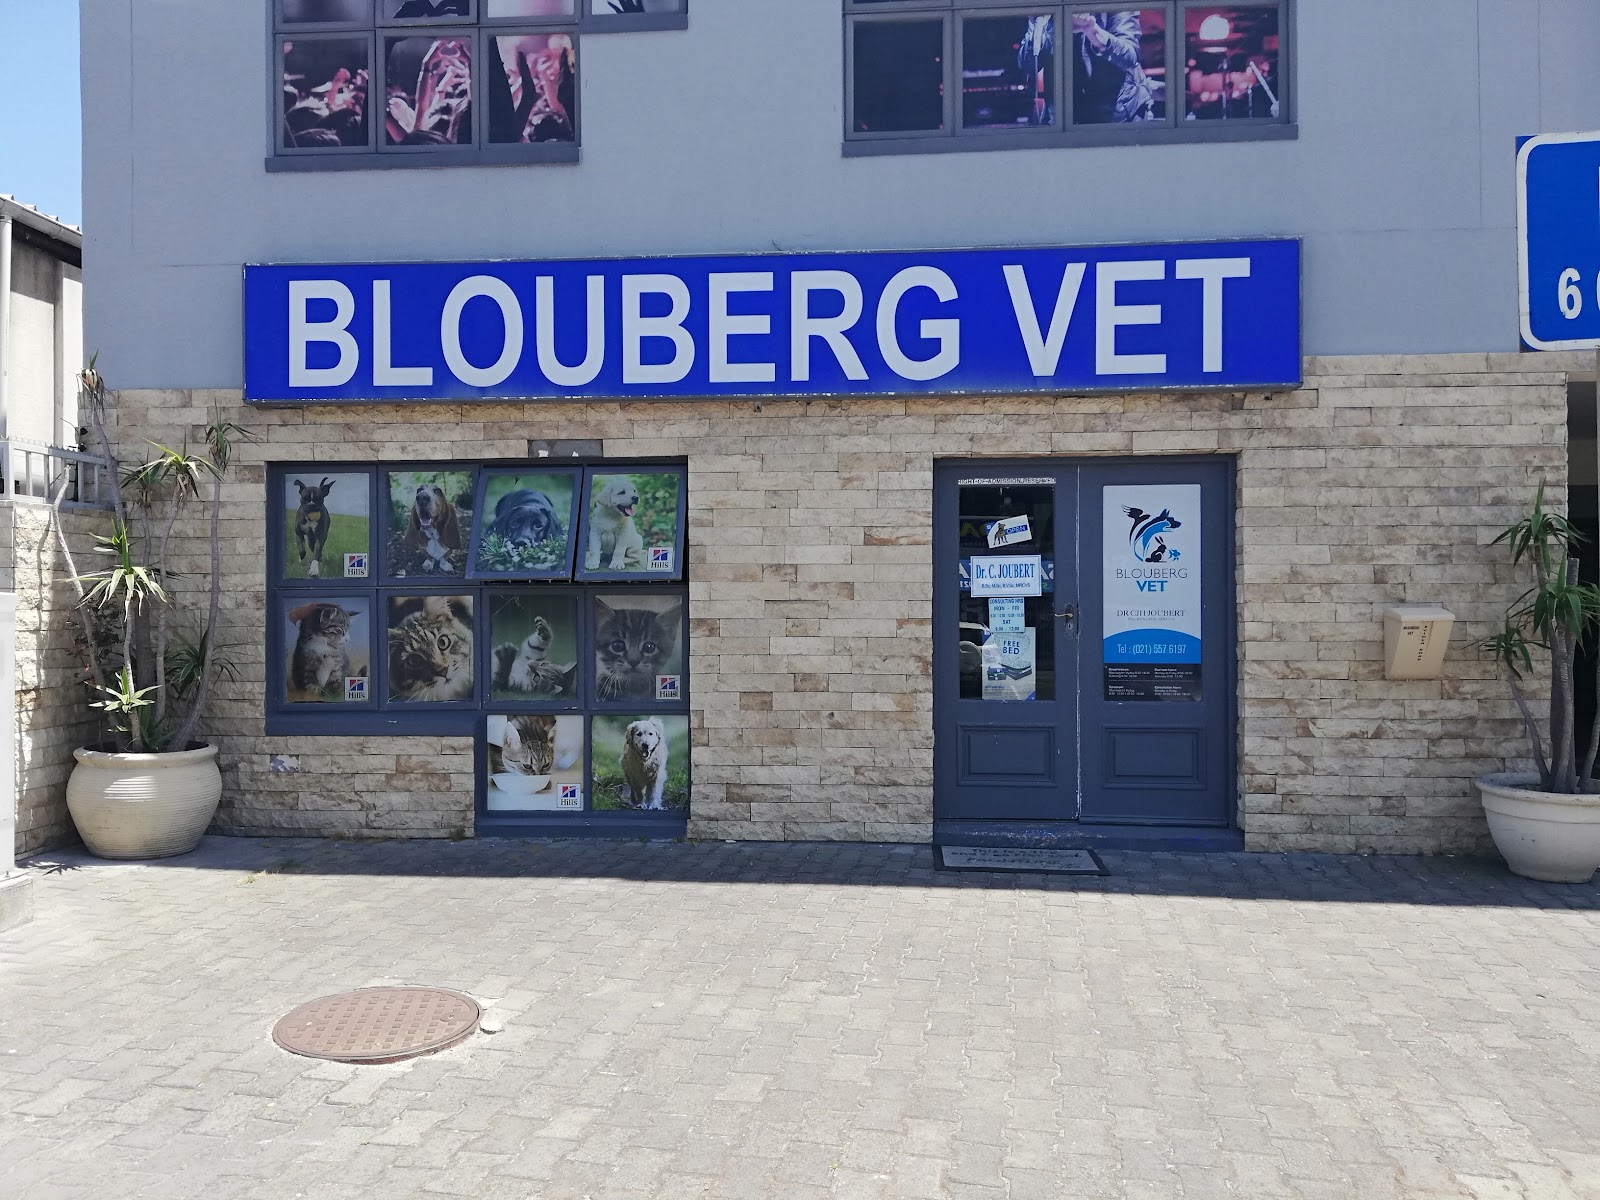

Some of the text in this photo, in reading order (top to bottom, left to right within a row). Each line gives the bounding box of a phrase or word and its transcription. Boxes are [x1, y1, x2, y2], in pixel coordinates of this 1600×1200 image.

[289, 258, 1251, 387] BLOUBERG VET
[1006, 525, 1026, 535] OPEN
[976, 564, 986, 579] Dr.
[998, 563, 1035, 579] JOUBERT
[1116, 568, 1188, 579] BLOUBERG
[1136, 580, 1168, 592] VET
[1003, 640, 1020, 648] FREE
[1132, 644, 1152, 655] (021)
[1153, 644, 1166, 654] 557
[1168, 644, 1187, 654] 6197
[1002, 647, 1020, 655] BED
